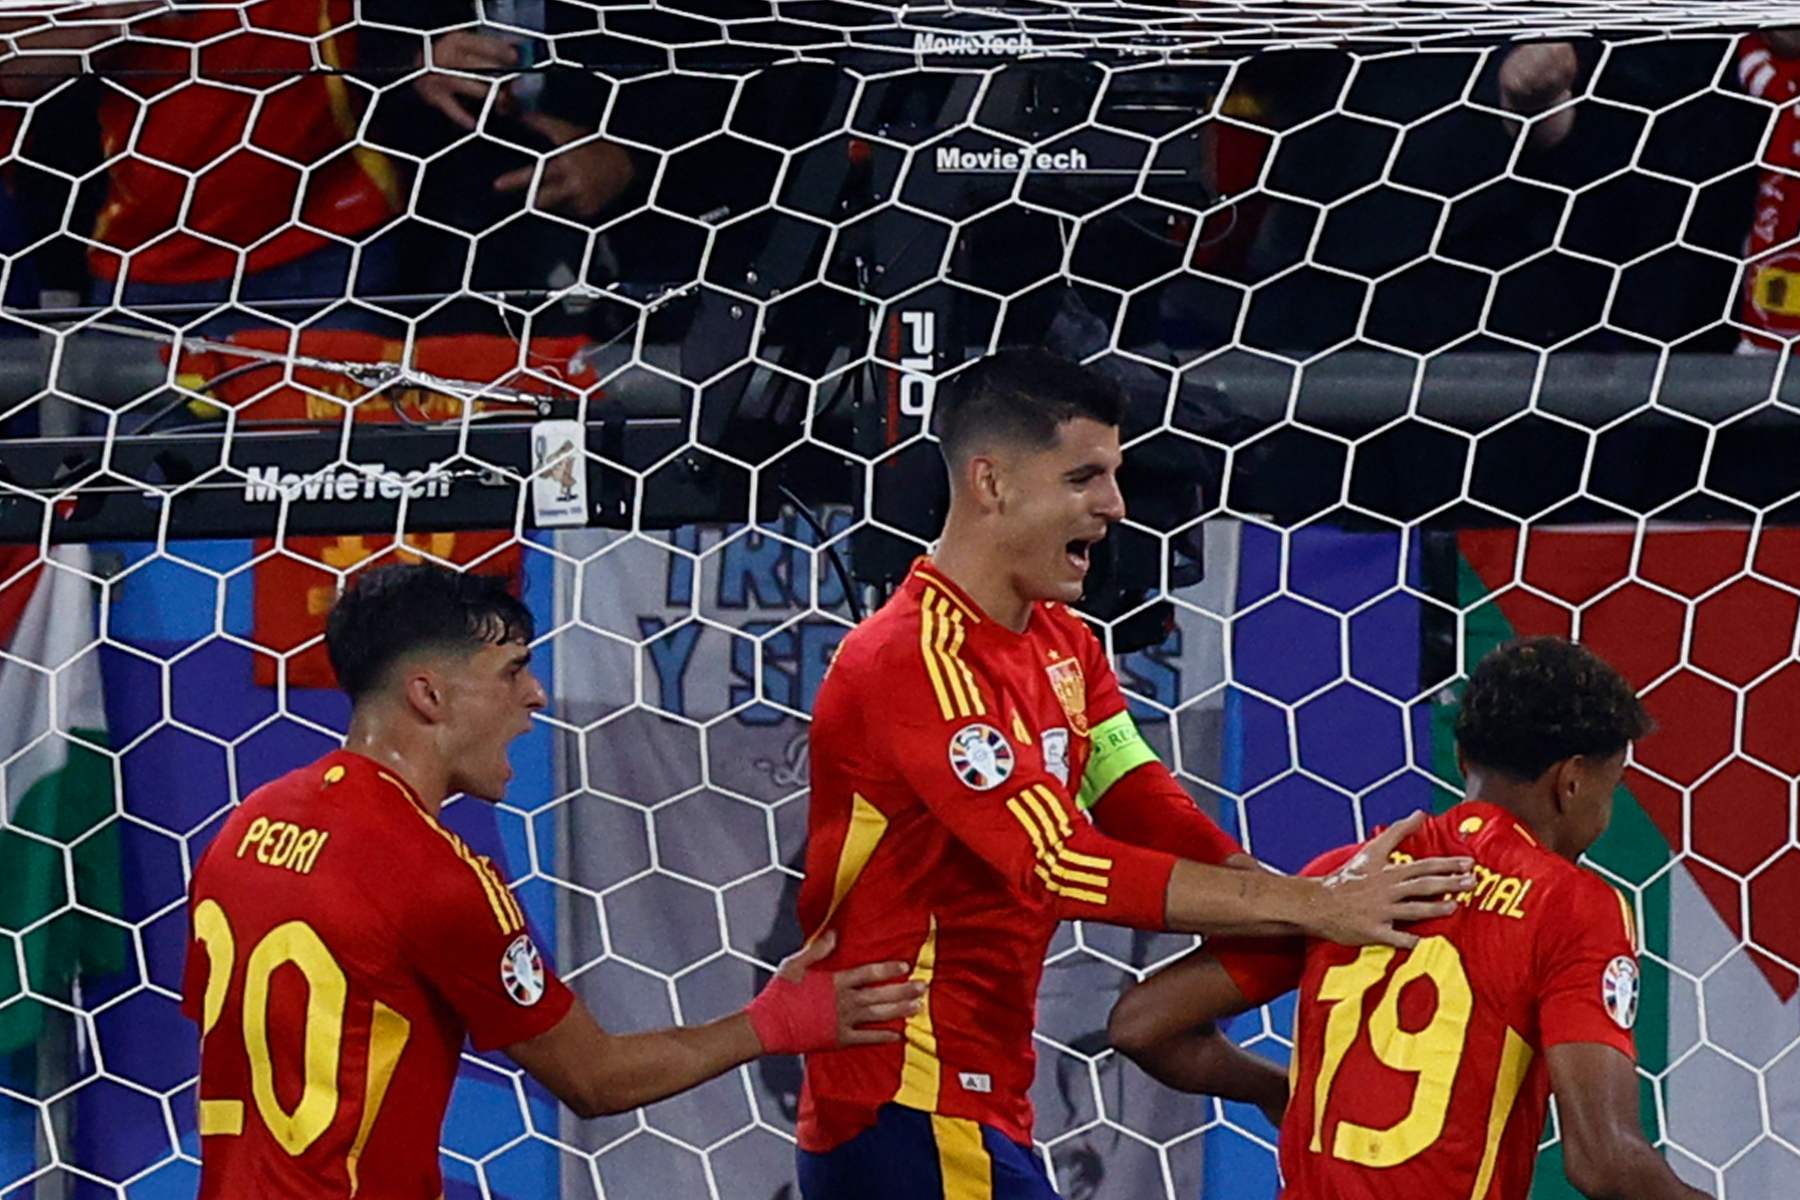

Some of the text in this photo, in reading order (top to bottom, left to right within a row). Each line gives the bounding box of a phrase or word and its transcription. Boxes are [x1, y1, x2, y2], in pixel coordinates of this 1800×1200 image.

[914, 32, 1034, 55] MovieTech
[936, 147, 1088, 170] MovieTech
[244, 463, 453, 502] MovieTech
[237, 816, 329, 874] PEDRI
[193, 898, 348, 1156] 20
[1308, 935, 1474, 1169] 19
